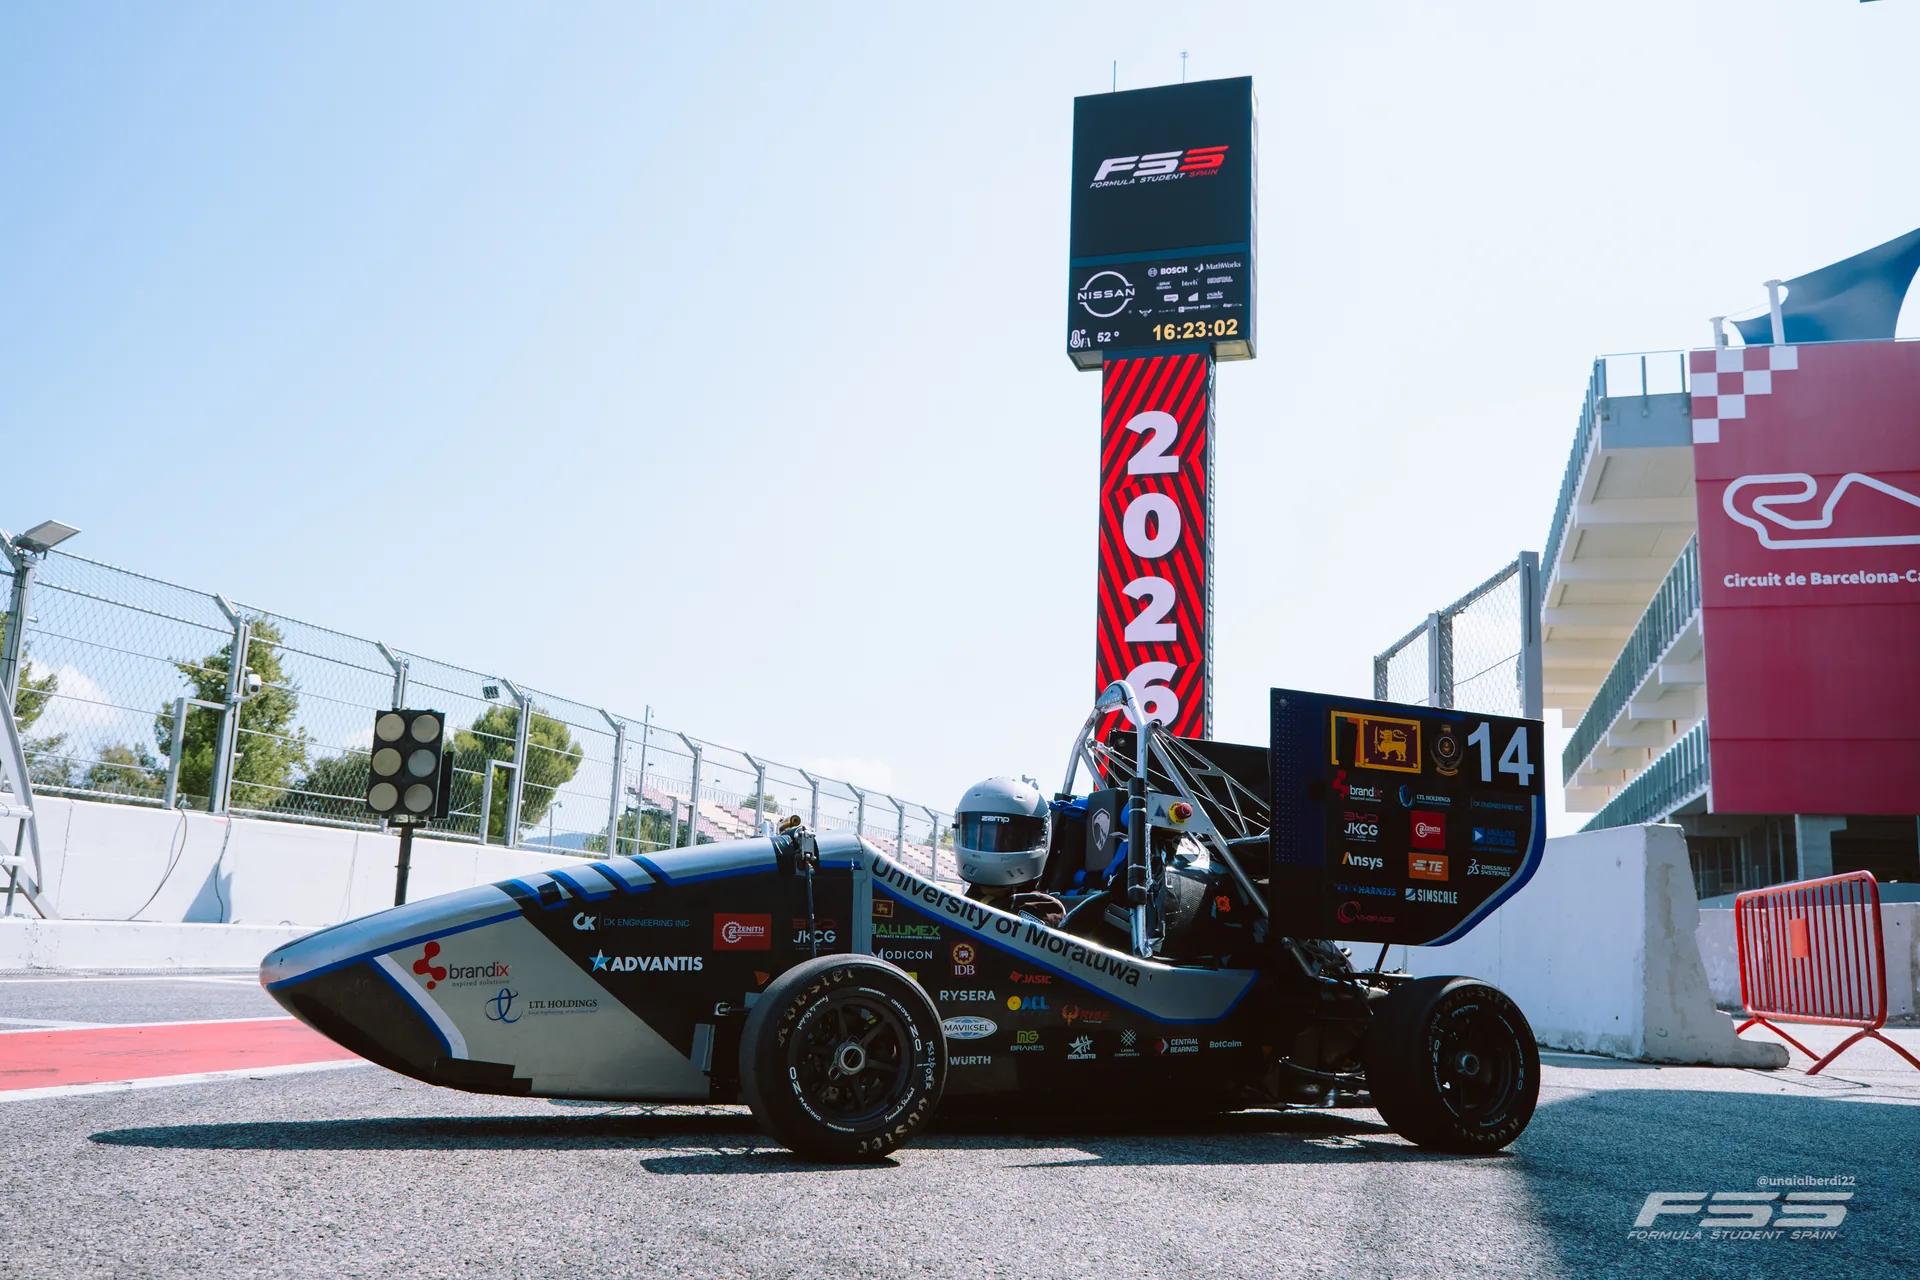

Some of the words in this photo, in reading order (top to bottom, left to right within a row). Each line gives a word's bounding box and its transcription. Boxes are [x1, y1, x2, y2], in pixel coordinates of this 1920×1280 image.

[1094, 146, 1229, 181] FSS
[1090, 178, 1135, 188] FORMULA
[1140, 172, 1185, 183] STUDENT
[1189, 168, 1218, 177] SPAIN
[1160, 265, 1188, 275] BOSCH
[1206, 261, 1241, 271] MathWorks
[1077, 288, 1135, 300] NISSAN
[1153, 318, 1238, 341] 16:23:02
[1723, 572, 1782, 588] Circuit
[1784, 572, 1806, 586] de
[1467, 721, 1535, 786] 14
[1425, 795, 1451, 803] HOLDINGS
[981, 815, 1009, 824] zamp
[1343, 822, 1379, 837] JKCG
[1341, 852, 1384, 870] Ansys
[1358, 885, 1397, 897] HARNESS
[1417, 889, 1458, 904] SIMSCALE
[603, 918, 616, 927] CK
[618, 918, 673, 928] ENGINEERING
[674, 919, 691, 928] INC
[871, 854, 993, 930] University
[995, 915, 1022, 938] of
[1024, 920, 1141, 987] Moratuwa
[610, 956, 704, 972] ADVANTIS
[449, 962, 509, 980] brandix
[954, 965, 976, 976] IDB
[1021, 975, 1052, 986] JASIC
[940, 989, 996, 1002] RYSERA
[529, 1000, 546, 1009] LTL
[547, 999, 598, 1009] HOLDINGS
[1020, 995, 1049, 1011] ACL
[944, 1024, 989, 1032] MAVIKSEL
[1010, 1044, 1045, 1052] BRAKES
[1170, 1038, 1199, 1047] CENTRAL
[1170, 1045, 1199, 1053] BEARINGS
[949, 1053, 992, 1066] WÜRTH
